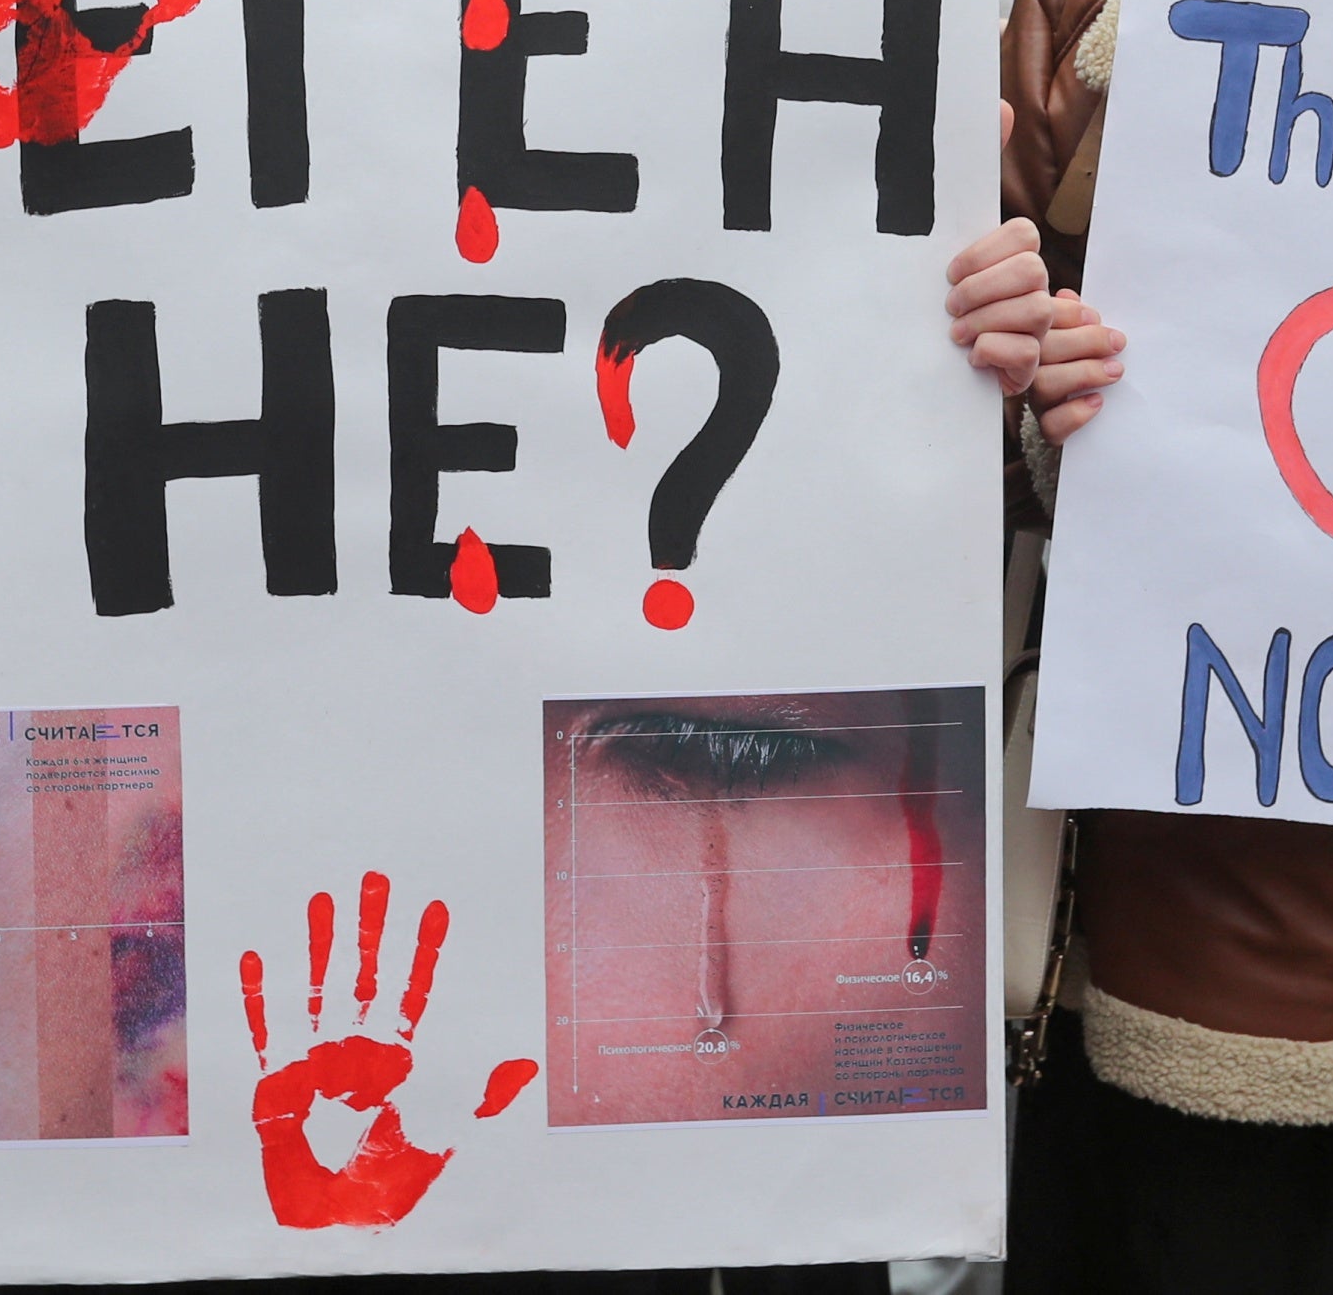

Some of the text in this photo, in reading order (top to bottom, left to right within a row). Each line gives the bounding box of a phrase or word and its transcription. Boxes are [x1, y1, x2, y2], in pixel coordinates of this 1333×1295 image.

[26, 757, 69, 766] Каждая
[93, 755, 148, 766] женщина
[26, 767, 160, 780] подвергается насилию
[26, 781, 154, 794] со стороны партнера
[836, 974, 900, 984] Физическое
[905, 971, 933, 984] 16,4
[835, 1022, 904, 1031] Физическое
[844, 1031, 946, 1044] психологическое
[598, 1043, 692, 1056] Психологическое
[696, 1042, 727, 1054] 20,8
[835, 1047, 883, 1056] насилие
[887, 1056, 955, 1067] Казахстана
[723, 1093, 808, 1109] КАЖДАЯ
